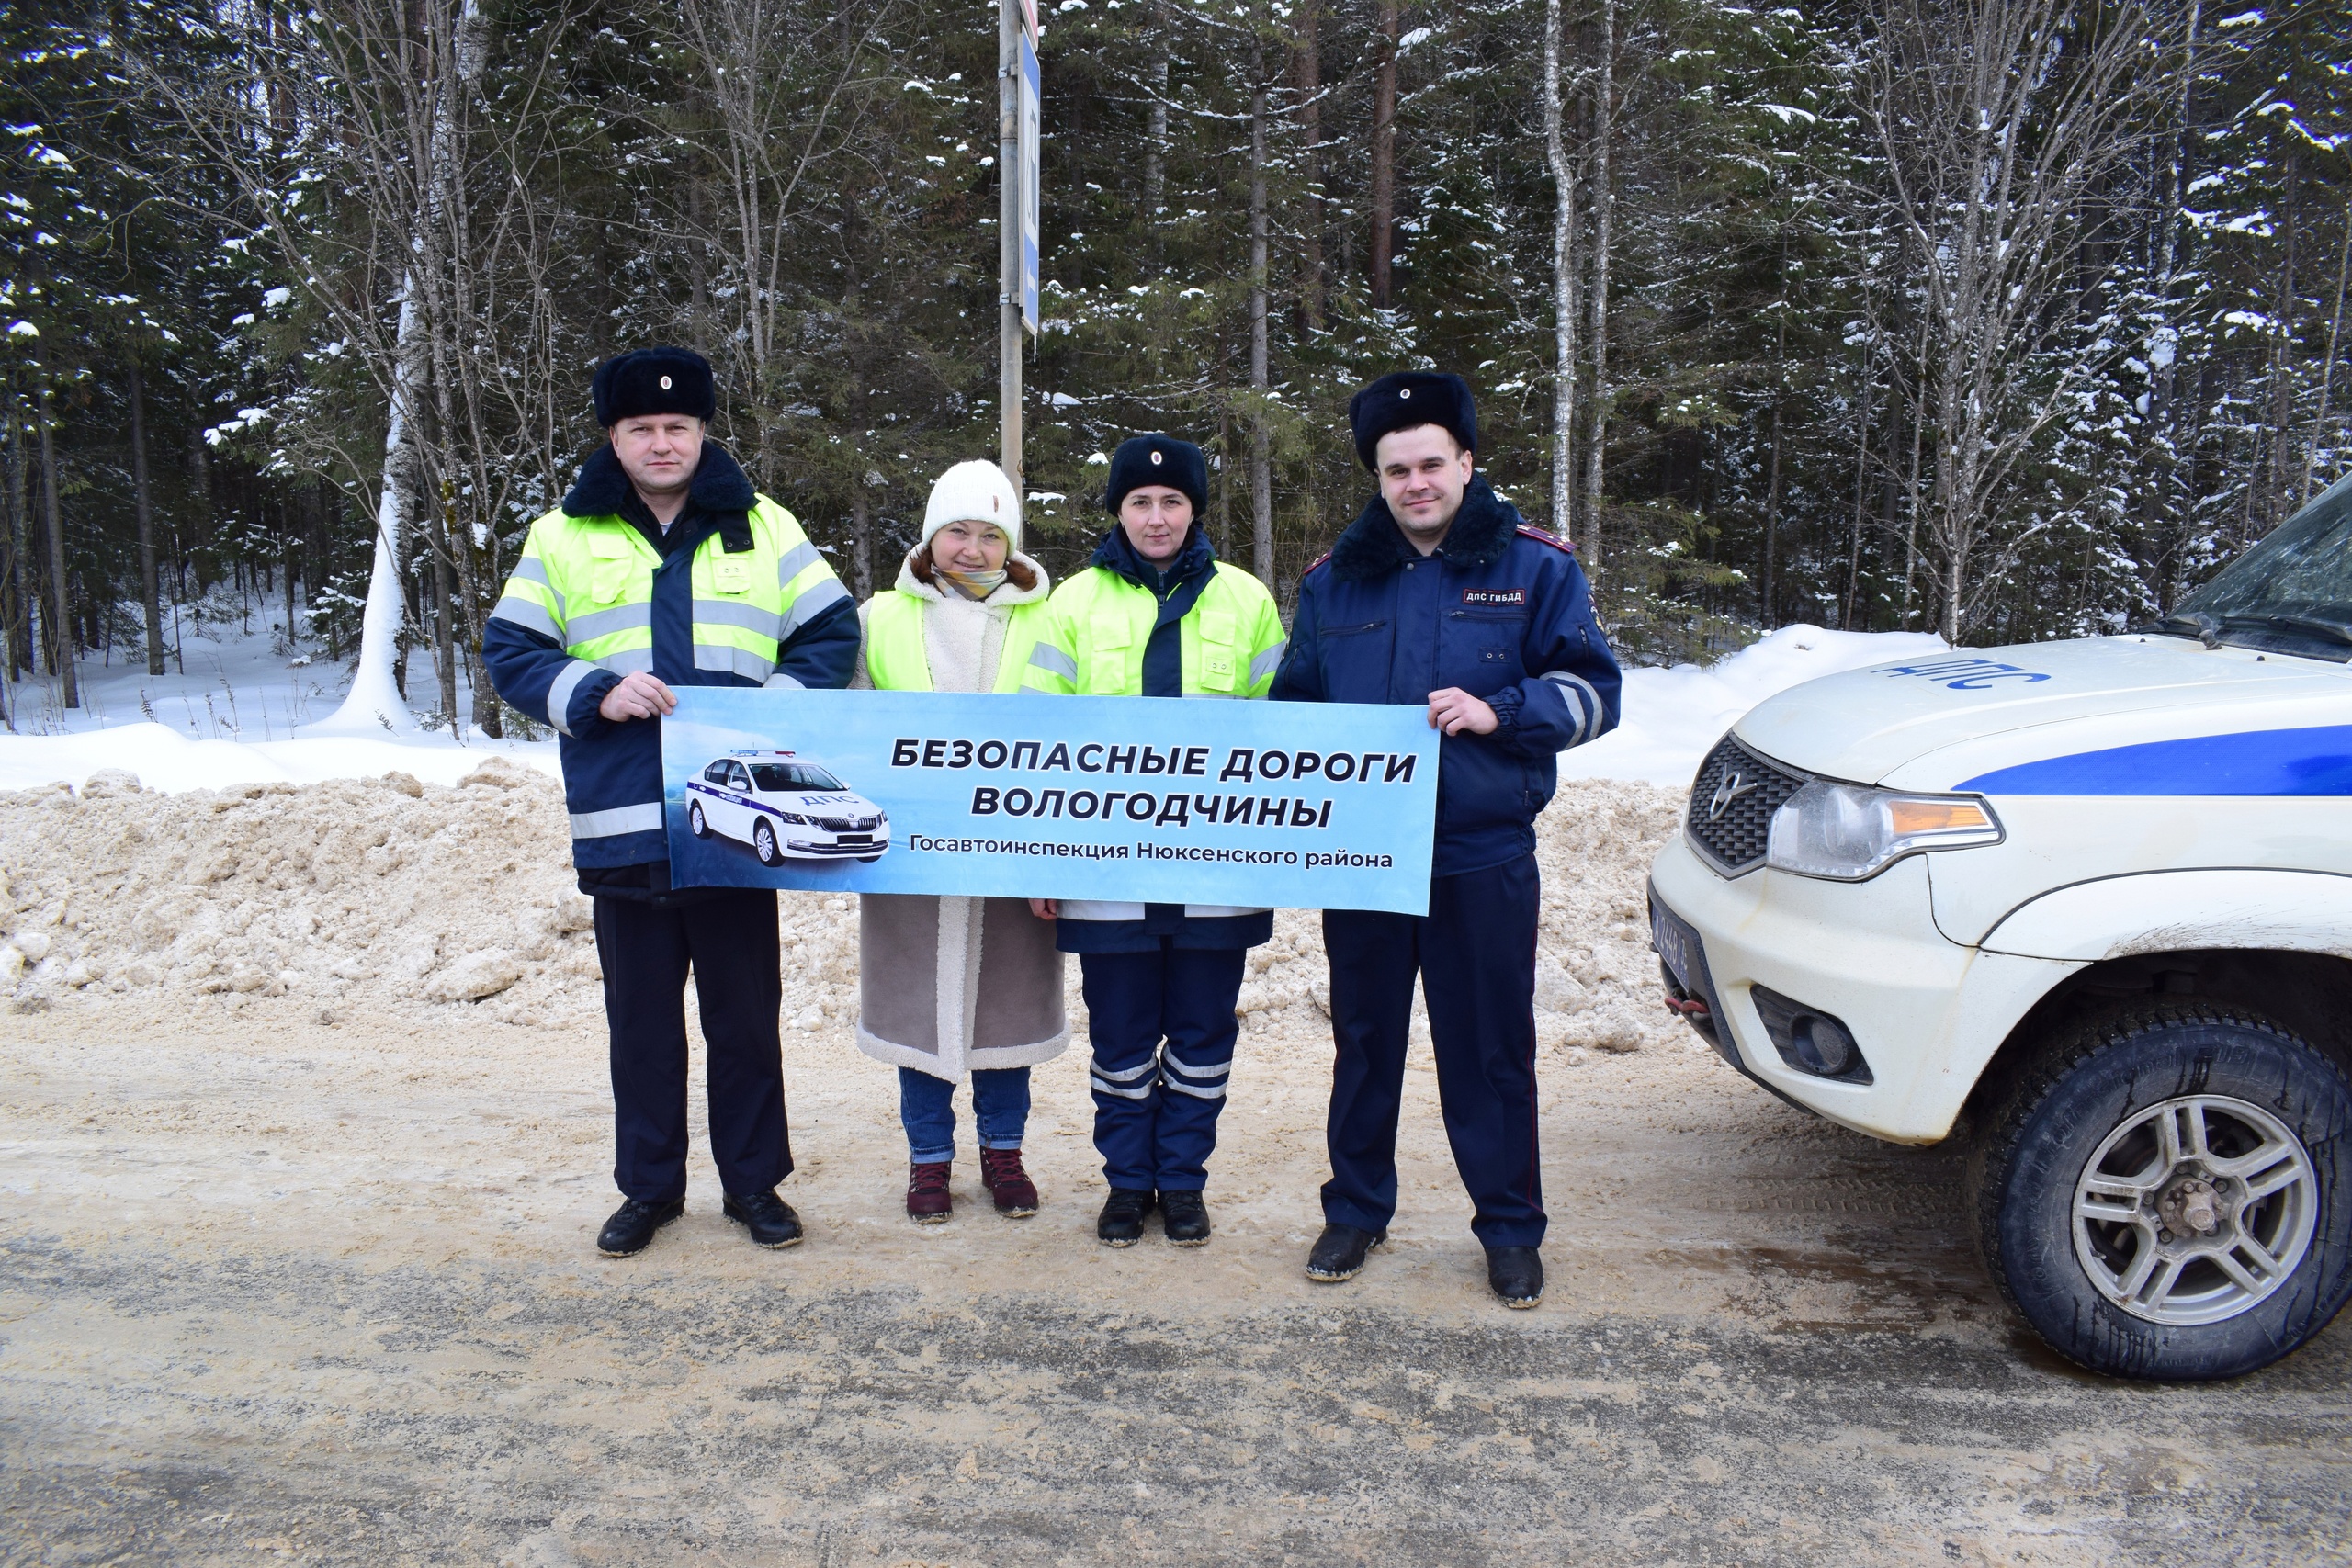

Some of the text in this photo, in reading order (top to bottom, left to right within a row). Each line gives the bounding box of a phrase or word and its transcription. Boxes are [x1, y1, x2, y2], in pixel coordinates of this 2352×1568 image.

[1466, 592, 1521, 602] ДПС ГИБДД
[1870, 659, 2052, 690] ДПС
[890, 739, 1418, 783] БЕЗОПАСНЫЕ ДОРОГИ
[799, 794, 859, 806] ДПС
[971, 786, 1333, 828] ВОЛОГОДЧИНЫ
[910, 833, 1394, 871] Госавтоинспекция Нюксенского района
[1660, 916, 1679, 965] 2448
